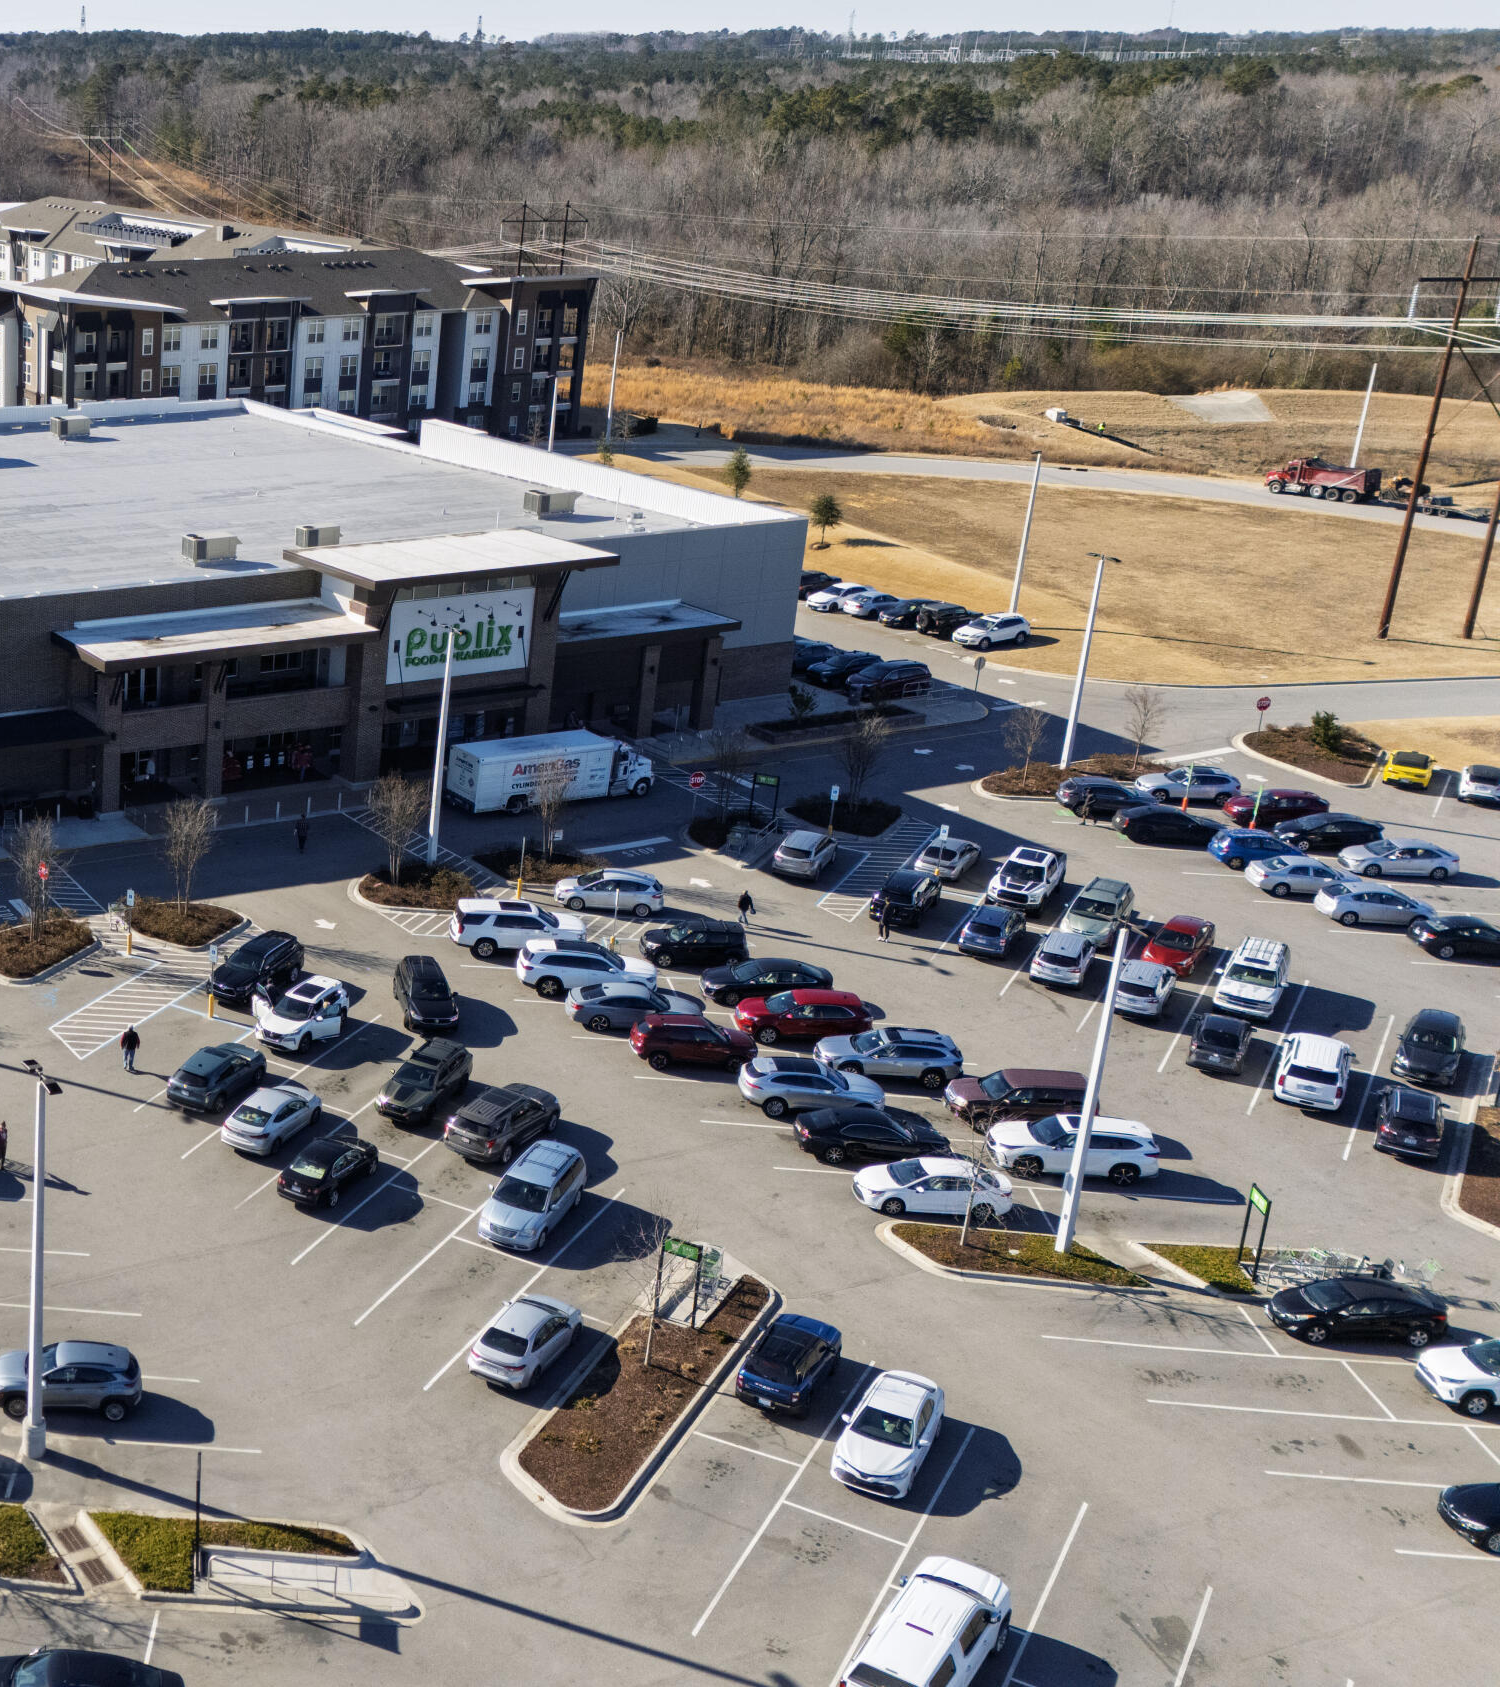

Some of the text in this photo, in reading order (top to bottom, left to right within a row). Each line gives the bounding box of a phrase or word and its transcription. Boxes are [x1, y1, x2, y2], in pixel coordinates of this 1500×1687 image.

[406, 618, 513, 657] Publix
[405, 654, 438, 667] FOOD
[690, 776, 706, 784] STOP
